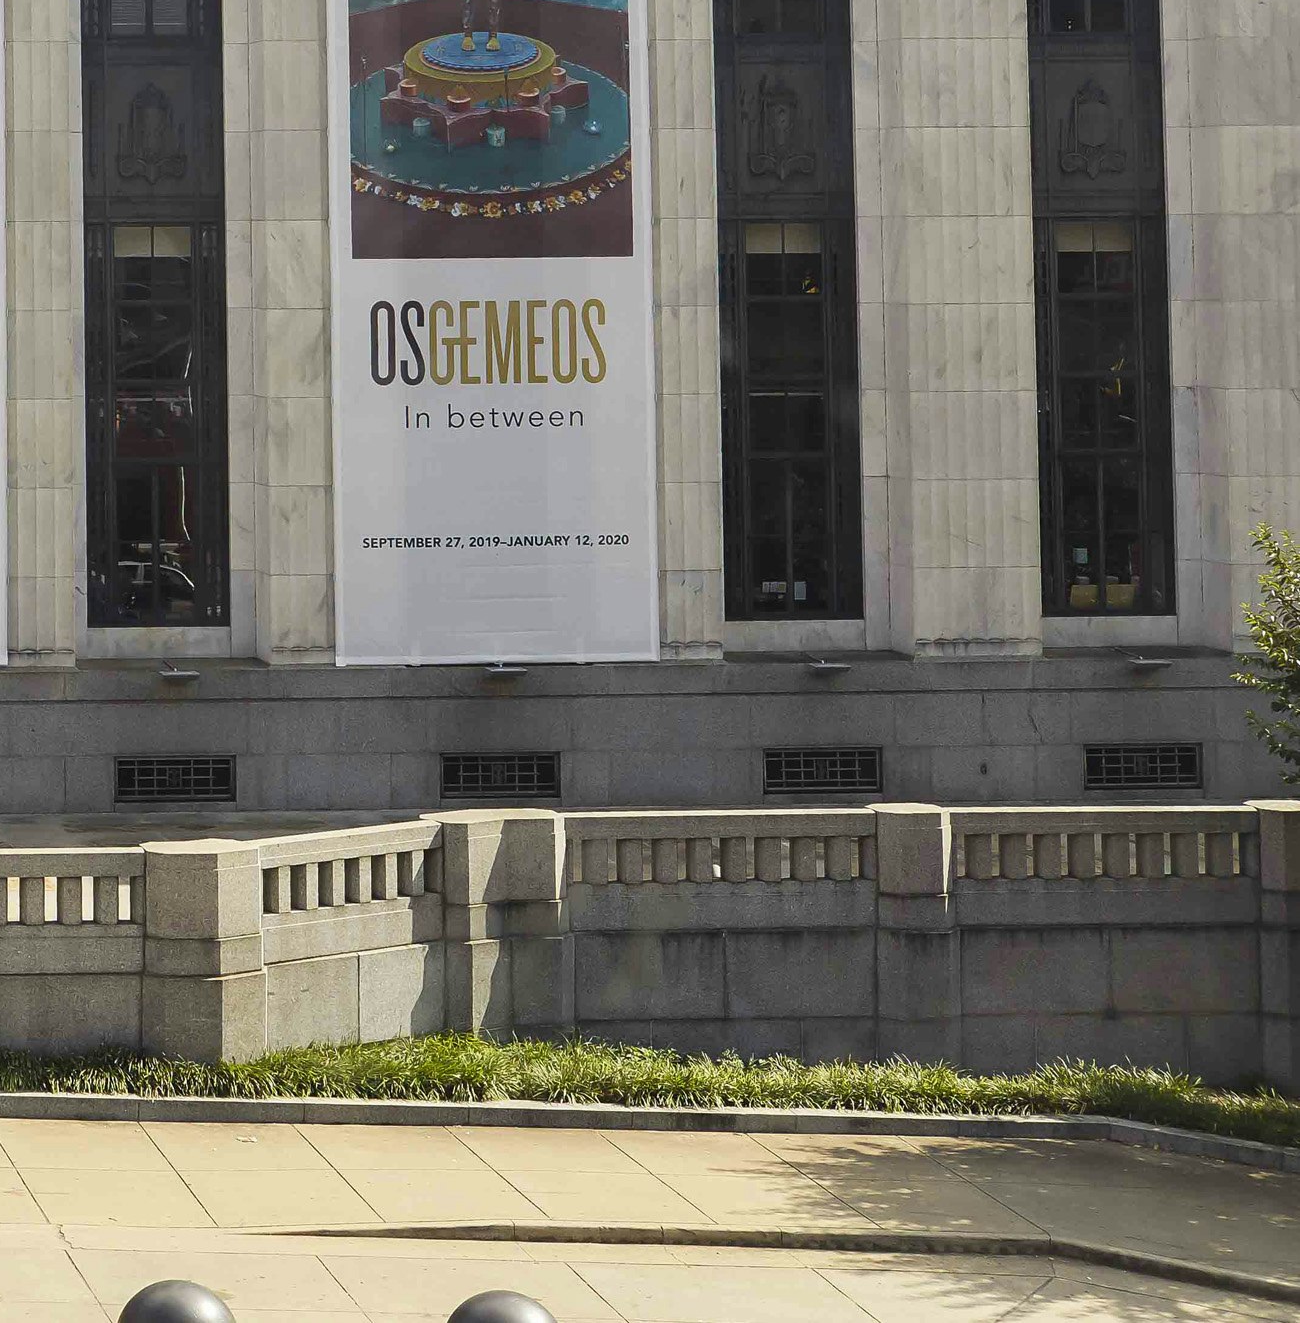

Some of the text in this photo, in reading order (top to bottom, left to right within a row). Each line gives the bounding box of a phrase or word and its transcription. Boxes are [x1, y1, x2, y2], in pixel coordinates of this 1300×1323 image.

[371, 299, 606, 385] OSGEMEOS
[406, 404, 583, 428] In between
[362, 536, 442, 549] SEPTEMBER
[445, 536, 465, 550] 27,
[574, 534, 594, 548] 12,
[598, 534, 630, 546] 2020
